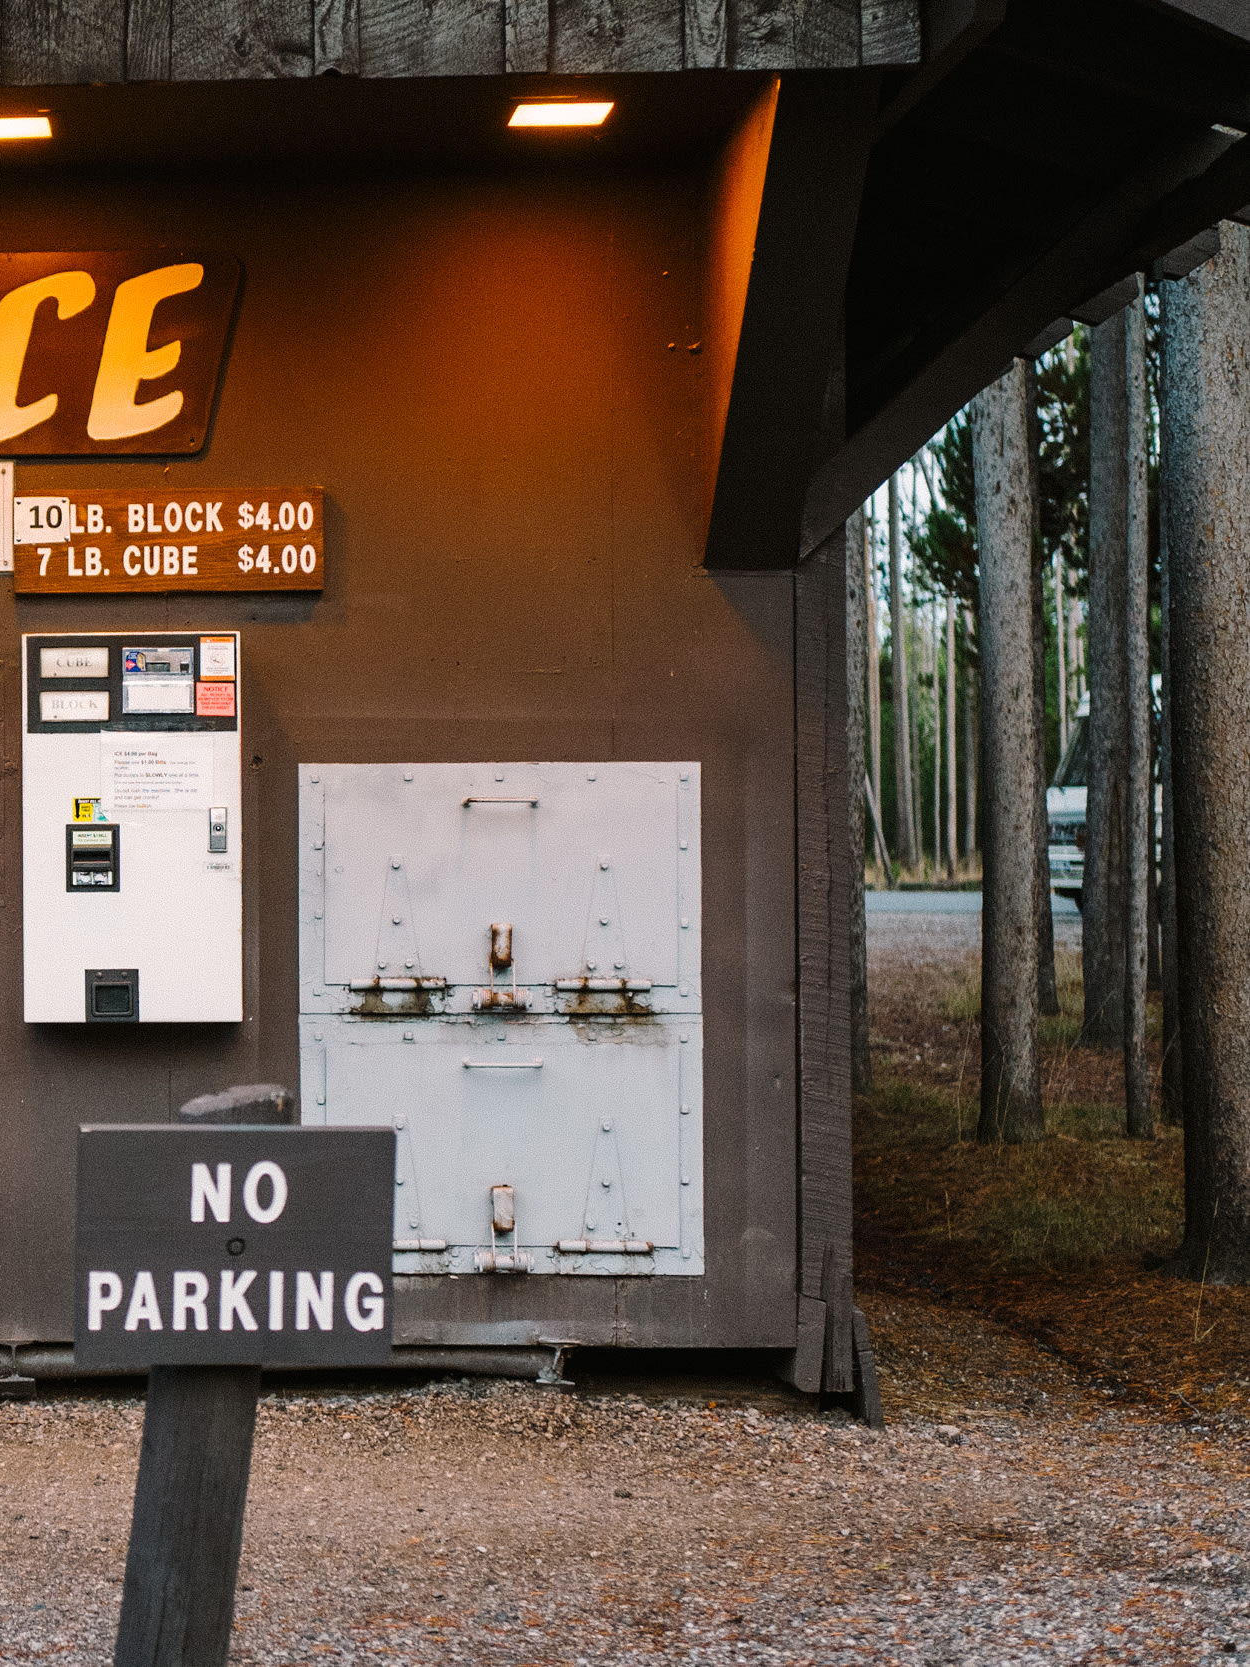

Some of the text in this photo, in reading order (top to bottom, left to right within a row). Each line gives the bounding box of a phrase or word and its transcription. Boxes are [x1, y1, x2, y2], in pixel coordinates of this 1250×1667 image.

[29, 500, 314, 534] 10 LB. BLOCK $4.00
[37, 543, 317, 576] 7 LB. CUBE $4.00
[56, 657, 93, 667] CUBE
[52, 699, 98, 709] BLOCK
[190, 1160, 289, 1224] NO
[87, 1269, 385, 1332] PARKING
